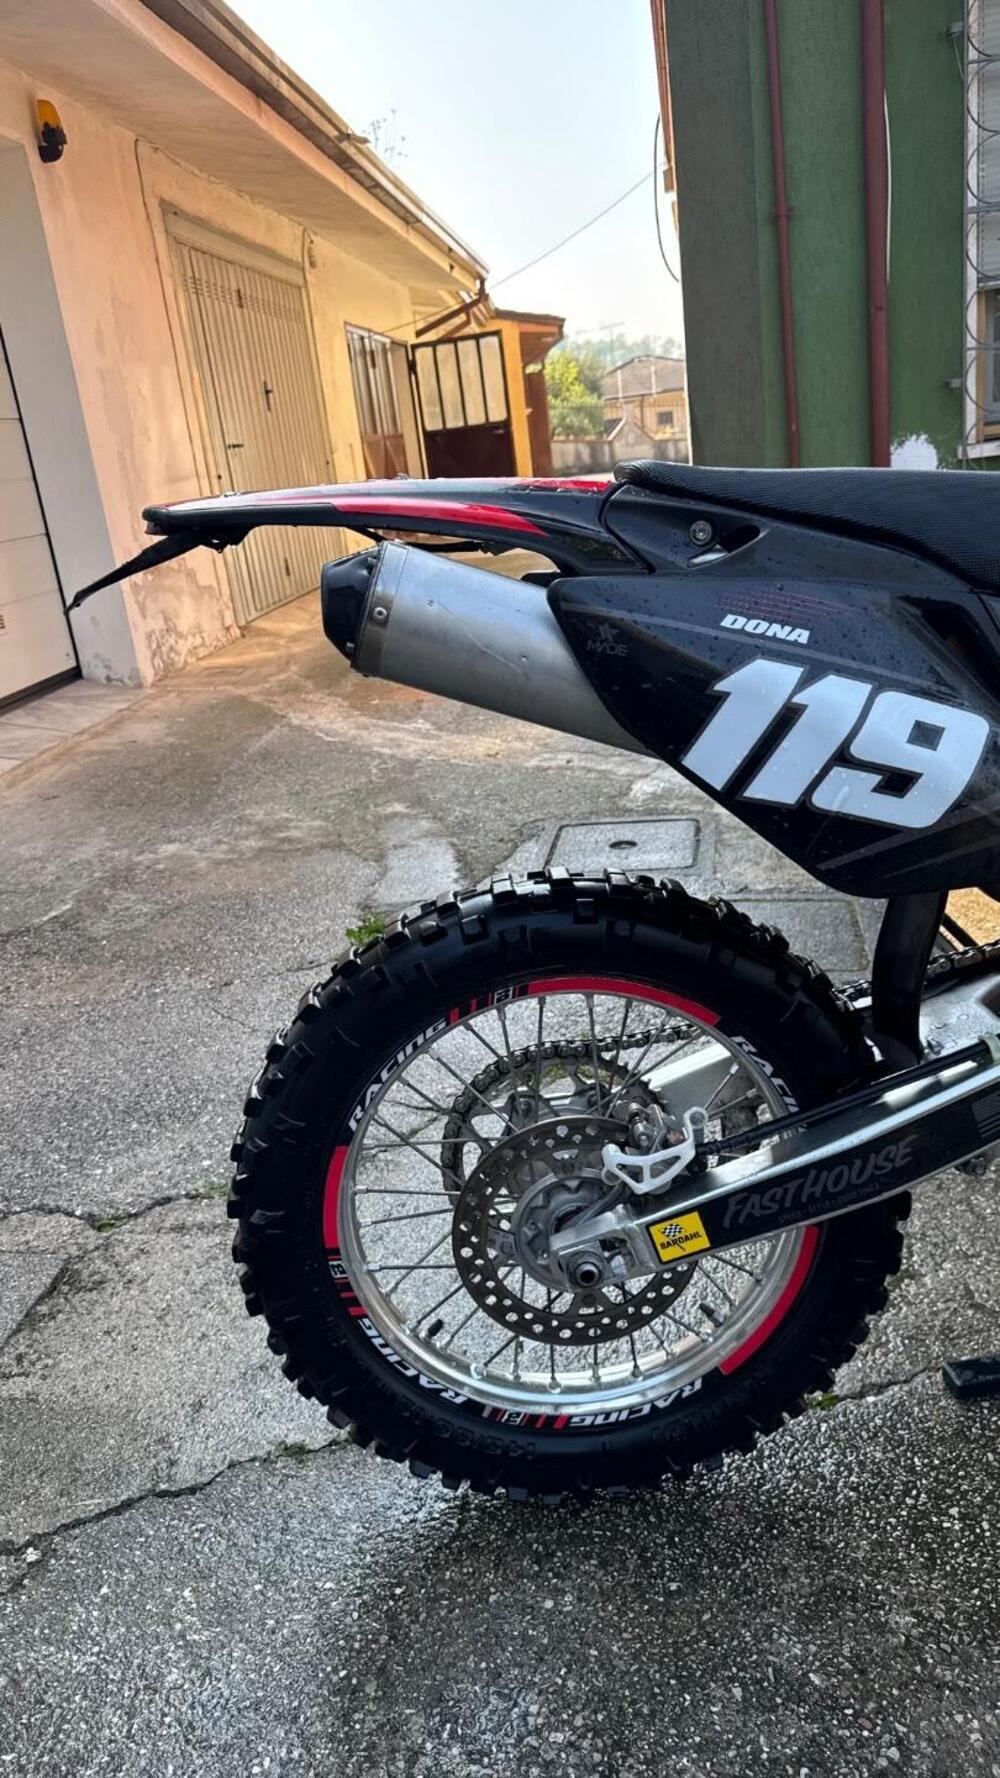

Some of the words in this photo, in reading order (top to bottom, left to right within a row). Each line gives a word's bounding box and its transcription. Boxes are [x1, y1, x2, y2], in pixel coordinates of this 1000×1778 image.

[719, 613, 811, 645] DONA
[681, 658, 991, 829] 119
[348, 1017, 447, 1133] RACING
[732, 1035, 802, 1114] RACI
[722, 1133, 920, 1229] FASTHOUSE
[659, 1231, 703, 1250] BARDAHL
[357, 1317, 469, 1405] RACING
[568, 1378, 703, 1427] RACING
